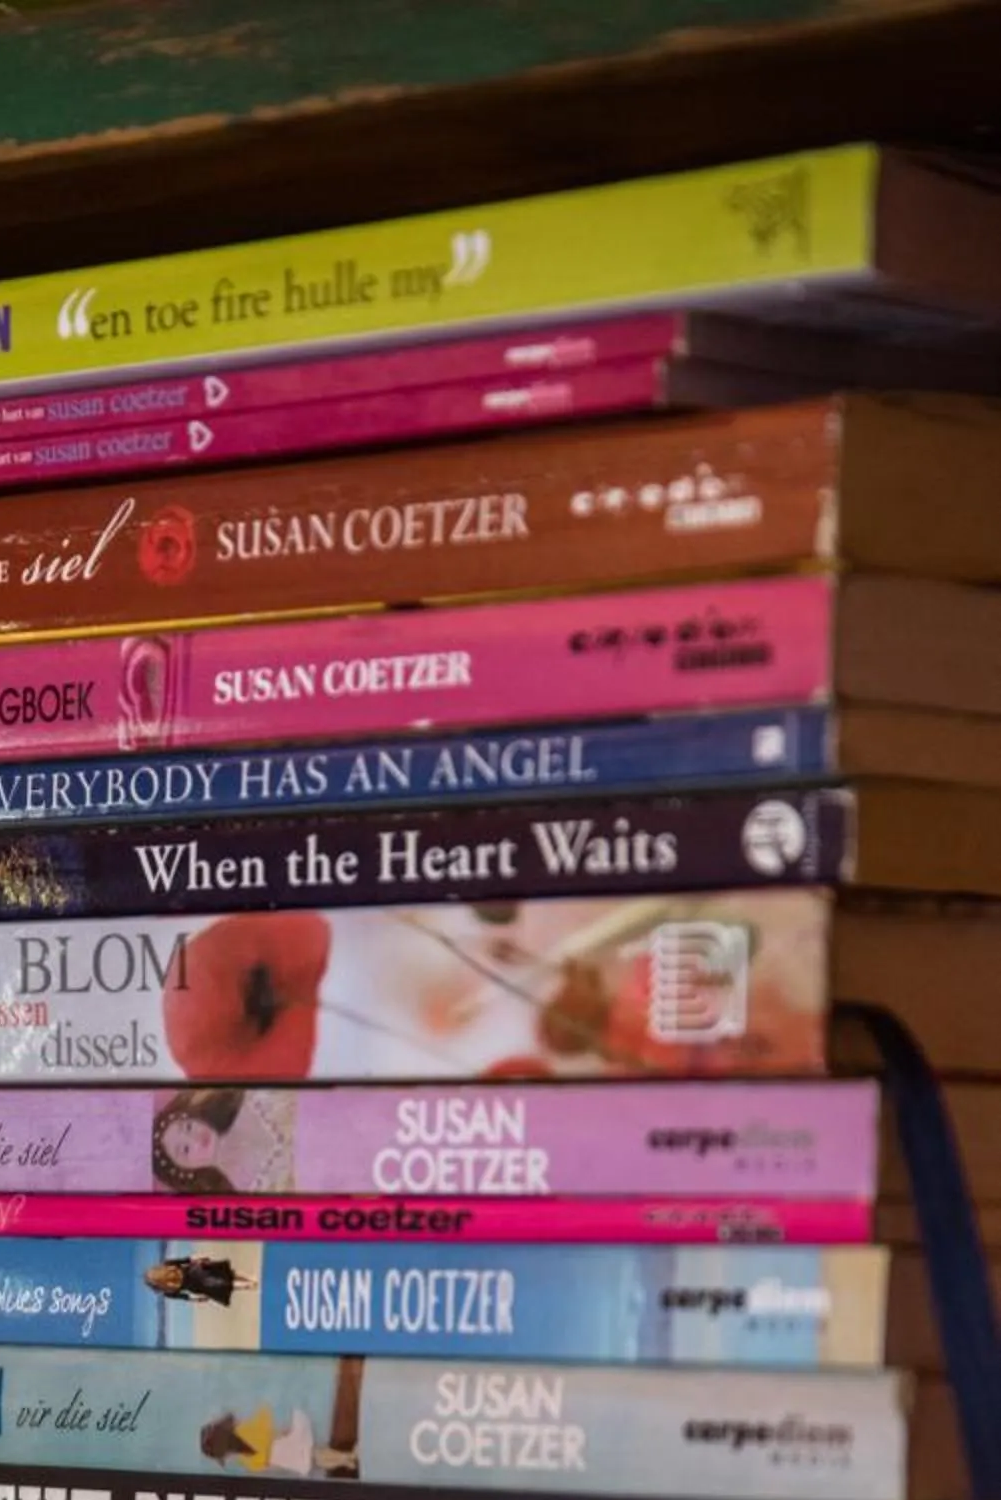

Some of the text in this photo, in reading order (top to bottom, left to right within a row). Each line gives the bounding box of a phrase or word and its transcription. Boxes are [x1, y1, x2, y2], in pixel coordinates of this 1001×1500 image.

[145, 299, 199, 332] toe
[211, 277, 271, 324] fire
[283, 259, 379, 314] hulle
[47, 395, 104, 421] susan
[112, 384, 188, 413] coetzer
[34, 438, 91, 465] susan
[96, 428, 174, 458] coetzer
[21, 497, 135, 586] siel
[216, 509, 336, 560] SUSAN
[343, 493, 529, 550] COETZER
[213, 659, 316, 706] SUSAN
[322, 651, 471, 698] COETZER
[239, 753, 328, 799] HAS
[344, 750, 412, 793] AN
[429, 735, 598, 790] ANGEL
[135, 843, 267, 893] When
[285, 834, 359, 885] the
[377, 828, 516, 882] Heart
[531, 817, 679, 880] Waits
[18, 932, 191, 995] BLOM
[41, 1022, 158, 1068] dissels
[19, 1123, 72, 1168] siel
[397, 1100, 526, 1146] SUSAN
[372, 1148, 550, 1195] COETZER
[186, 1206, 303, 1231] susan
[319, 1201, 474, 1234] coetzer
[49, 1286, 111, 1338] songs
[285, 1267, 372, 1332] SUSAN
[385, 1267, 515, 1335] COETZER
[16, 1403, 51, 1427] vir
[54, 1388, 91, 1430] die
[96, 1390, 152, 1433] siel
[435, 1374, 563, 1420] SUSAN
[410, 1420, 588, 1472] COETZER
